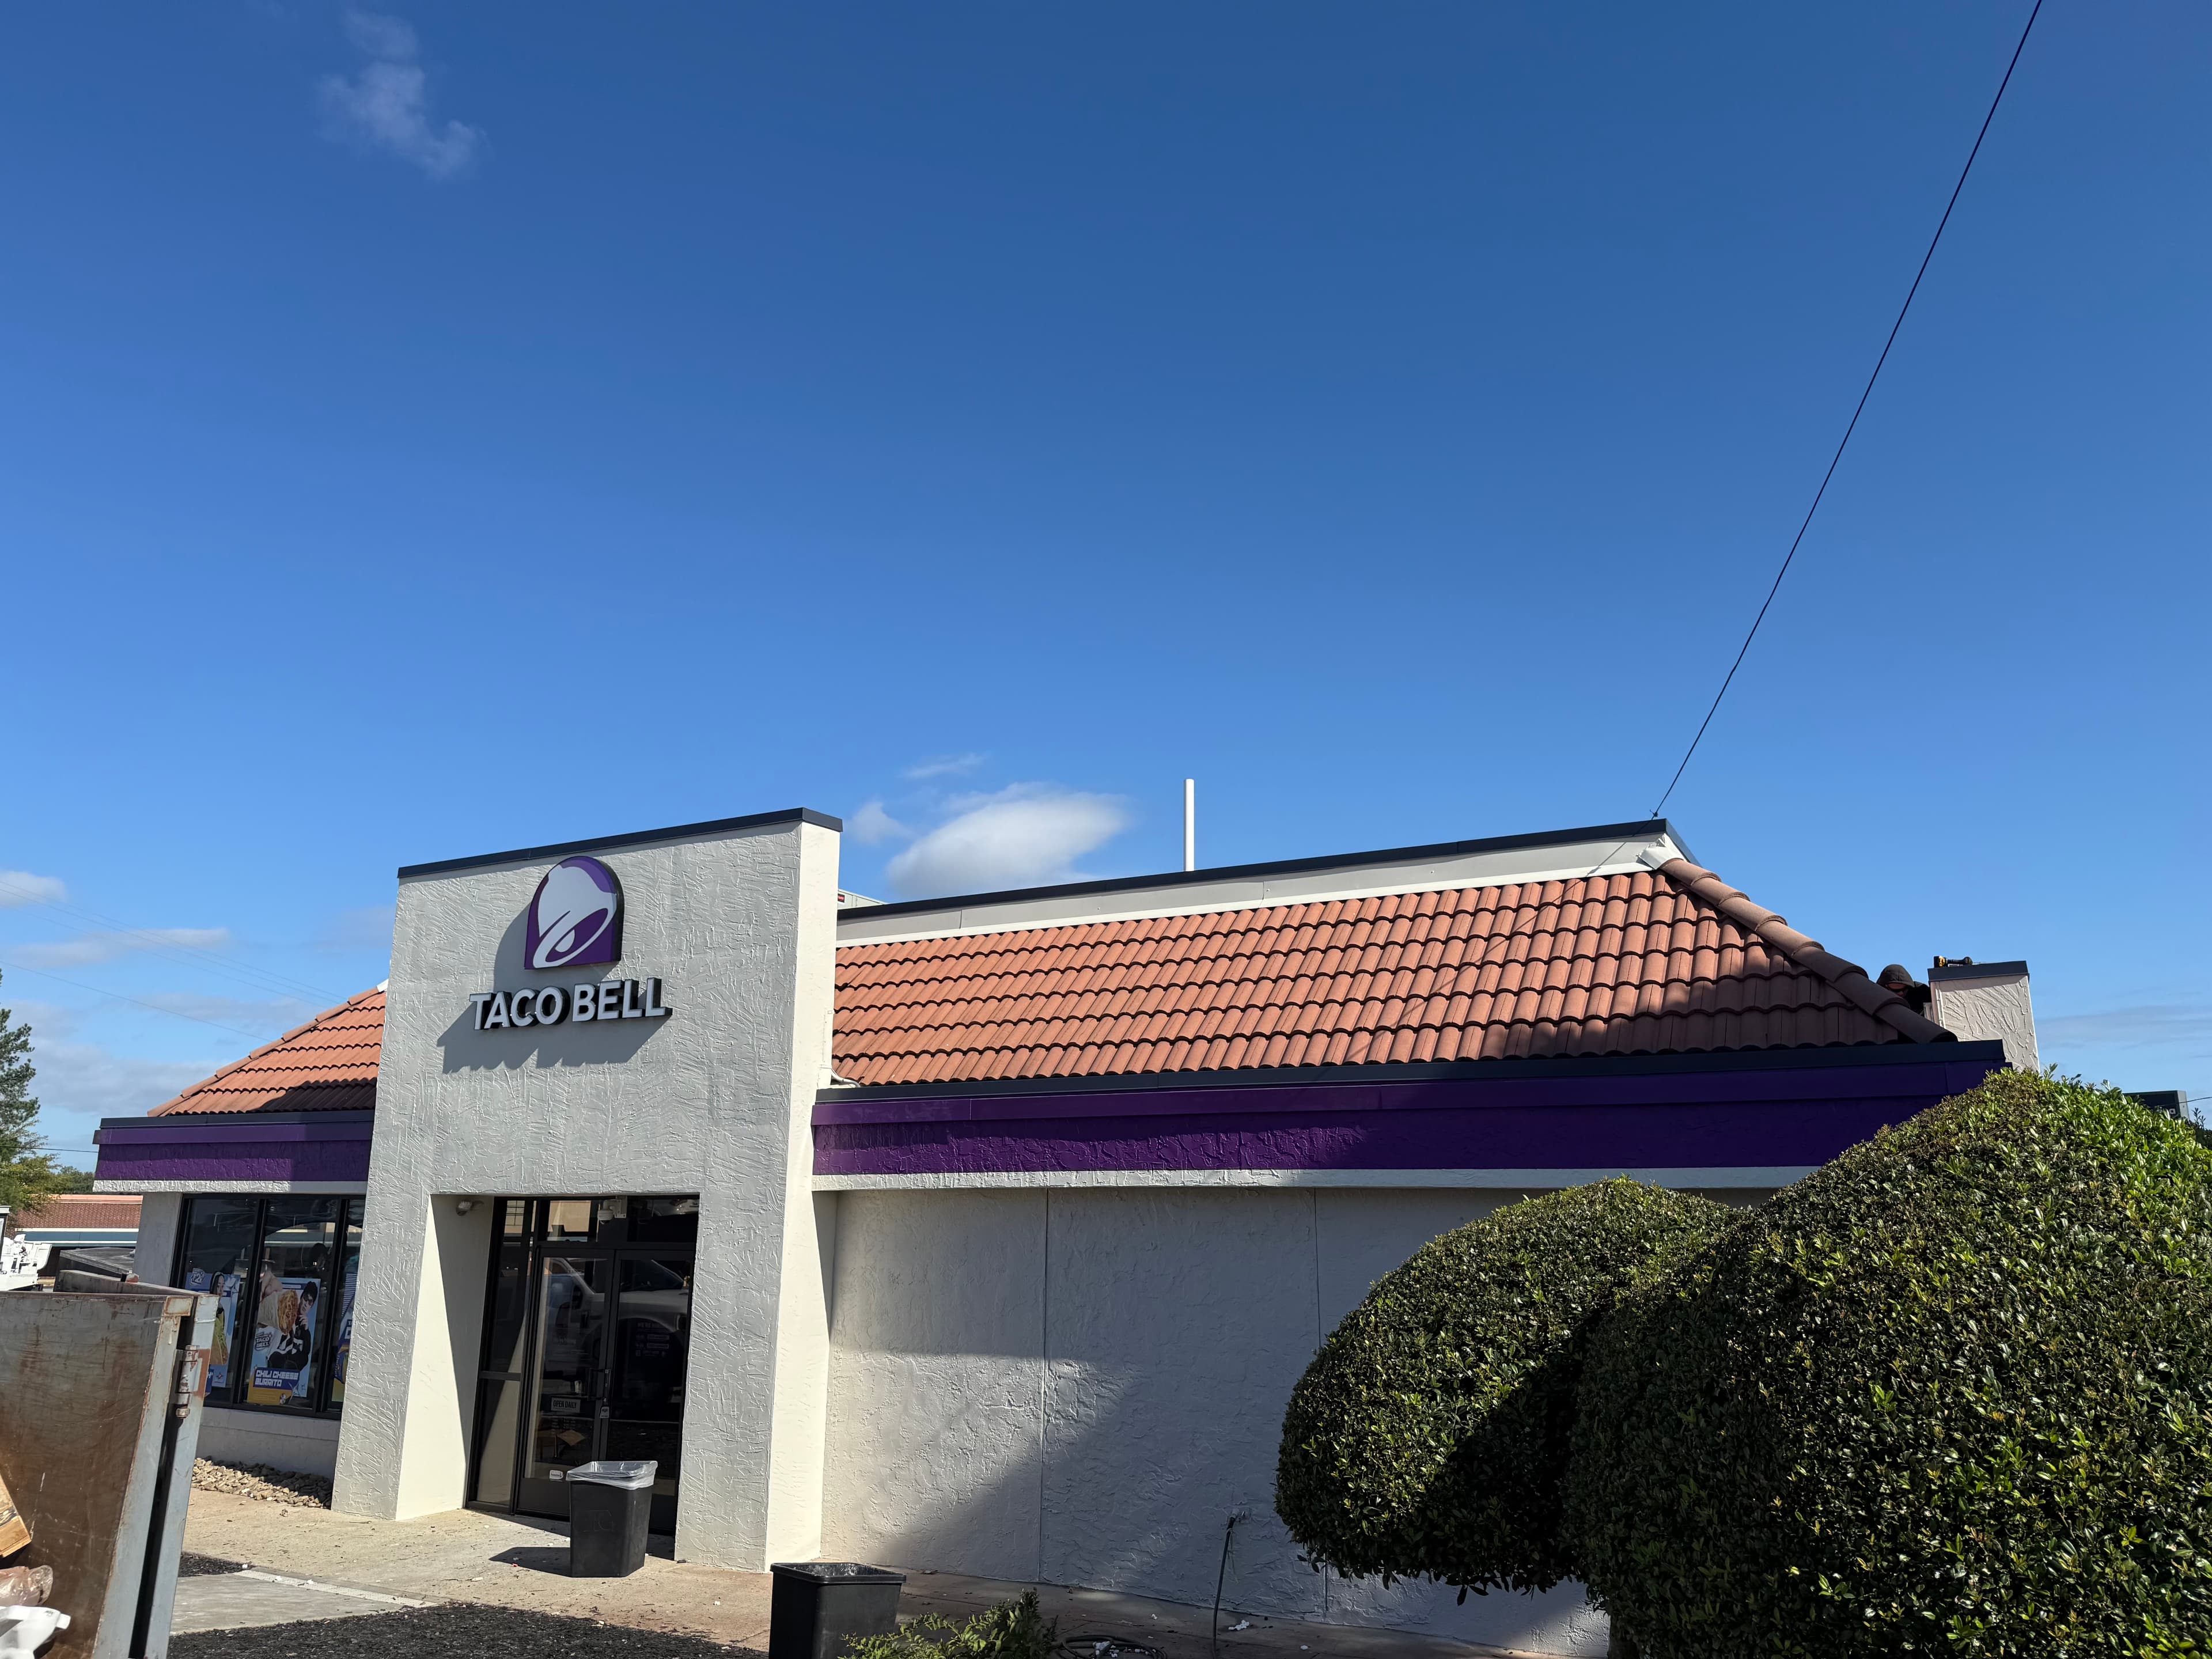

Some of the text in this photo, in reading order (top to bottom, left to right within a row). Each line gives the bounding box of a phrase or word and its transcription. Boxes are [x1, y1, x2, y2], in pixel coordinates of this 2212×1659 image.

[469, 978, 672, 1031] TACO BELL
[256, 1370, 299, 1380] CHILI CHEESE
[255, 1377, 282, 1387] BURRITO
